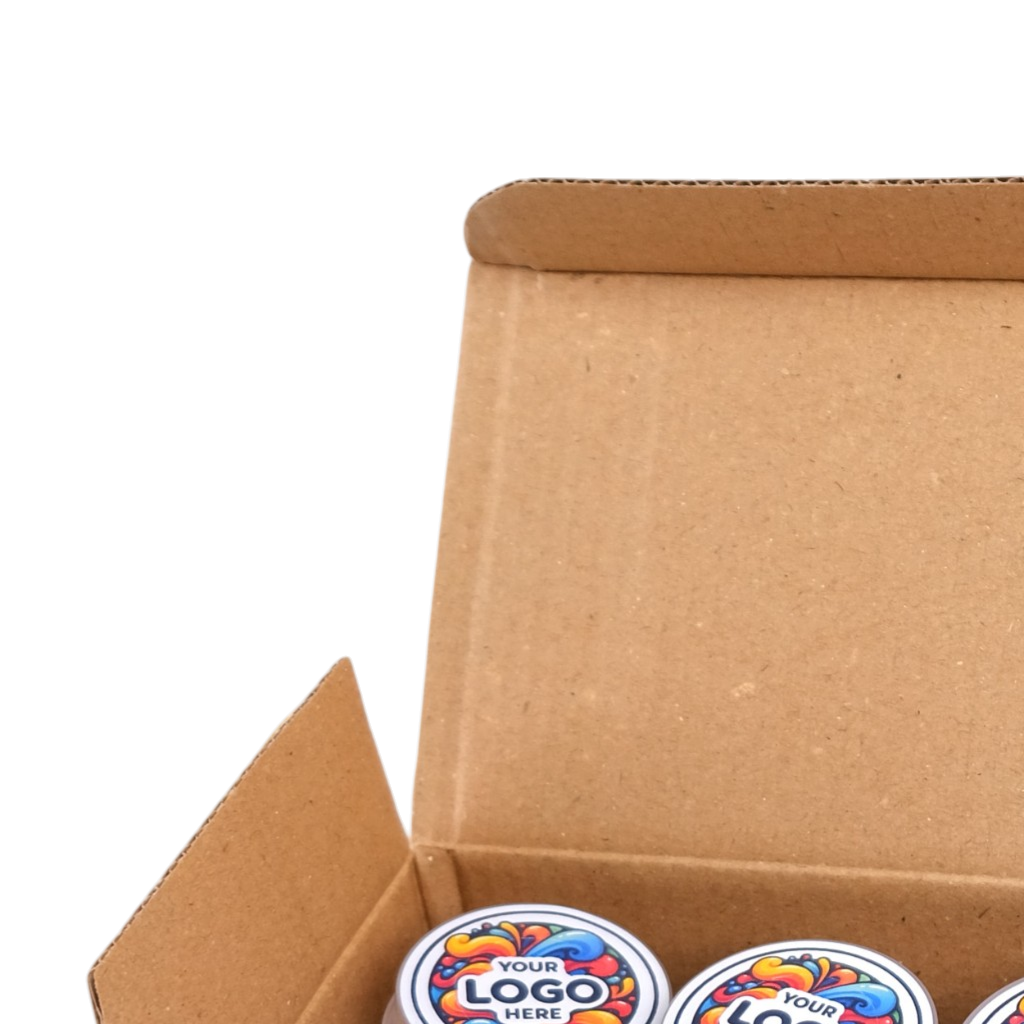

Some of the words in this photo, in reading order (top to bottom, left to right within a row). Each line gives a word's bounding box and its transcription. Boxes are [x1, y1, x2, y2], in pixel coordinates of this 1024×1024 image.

[498, 961, 558, 972] YOUR
[465, 978, 603, 1004] LOGO
[505, 1008, 562, 1020] HERE
[783, 992, 837, 1018] YOUR
